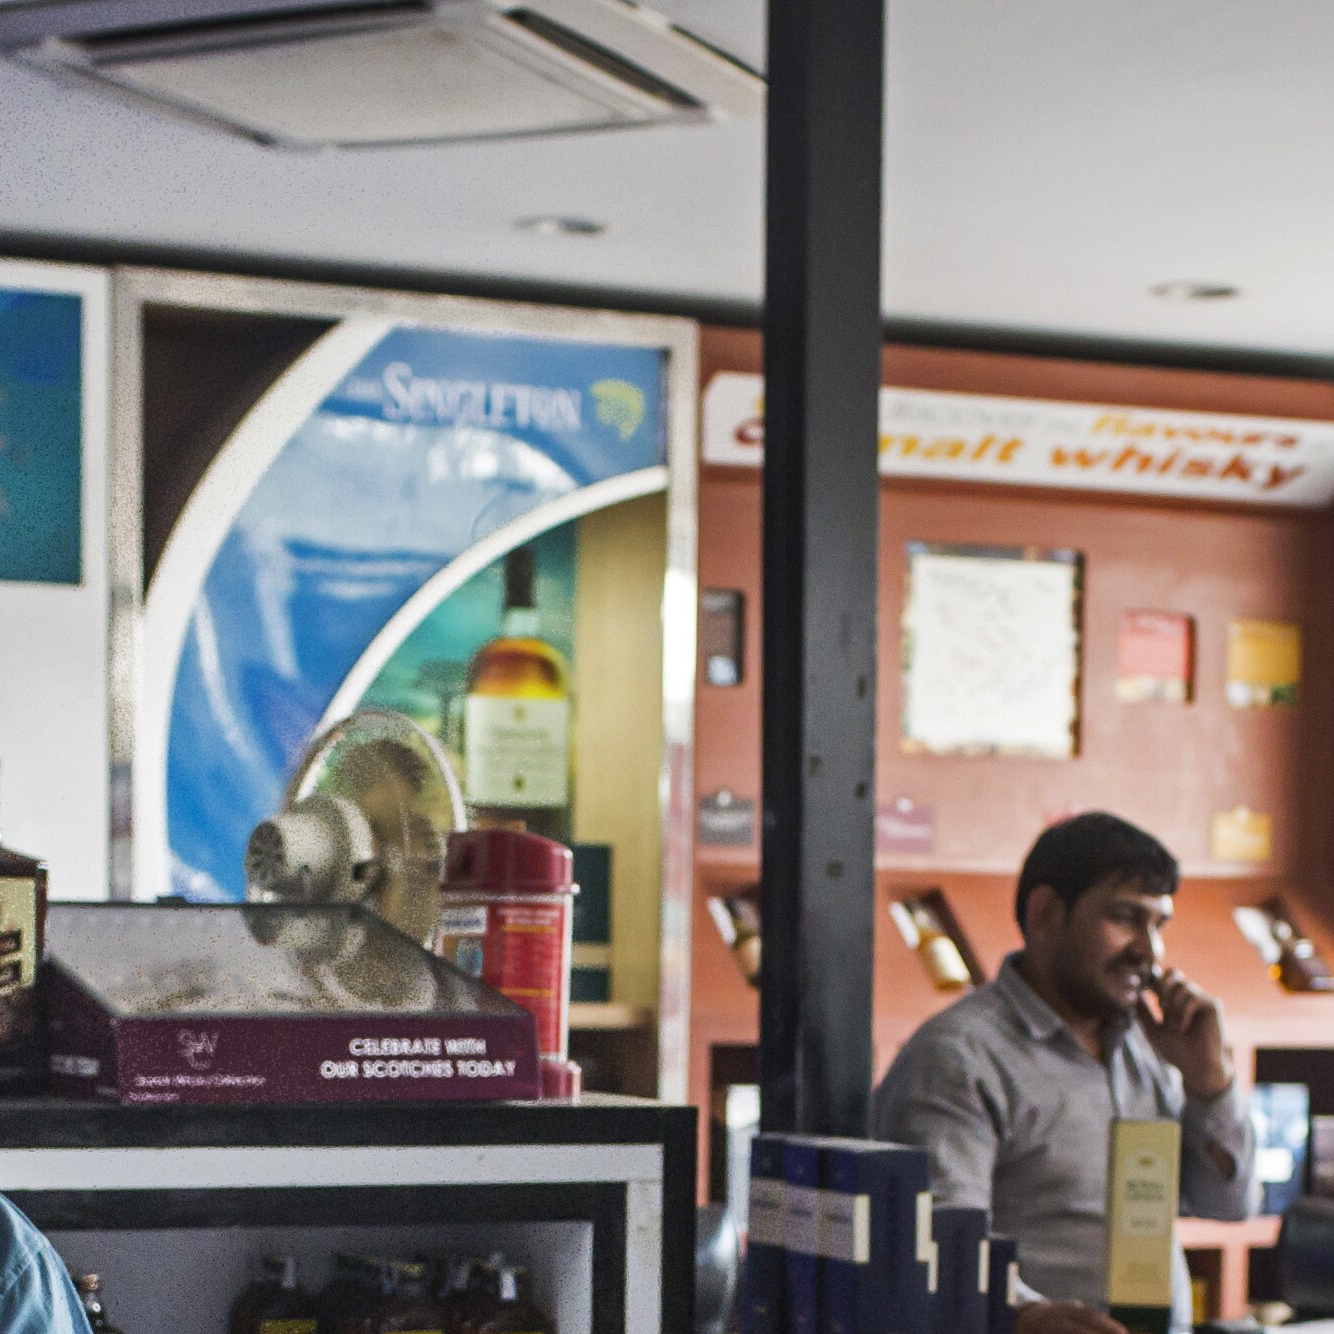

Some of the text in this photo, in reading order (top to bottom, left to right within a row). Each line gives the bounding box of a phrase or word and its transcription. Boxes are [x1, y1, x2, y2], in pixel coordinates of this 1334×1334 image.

[1050, 445, 1308, 492] whisky
[348, 1037, 442, 1056] CELEBRATE
[320, 1059, 517, 1080] OUR SCOTCHES TODAY
